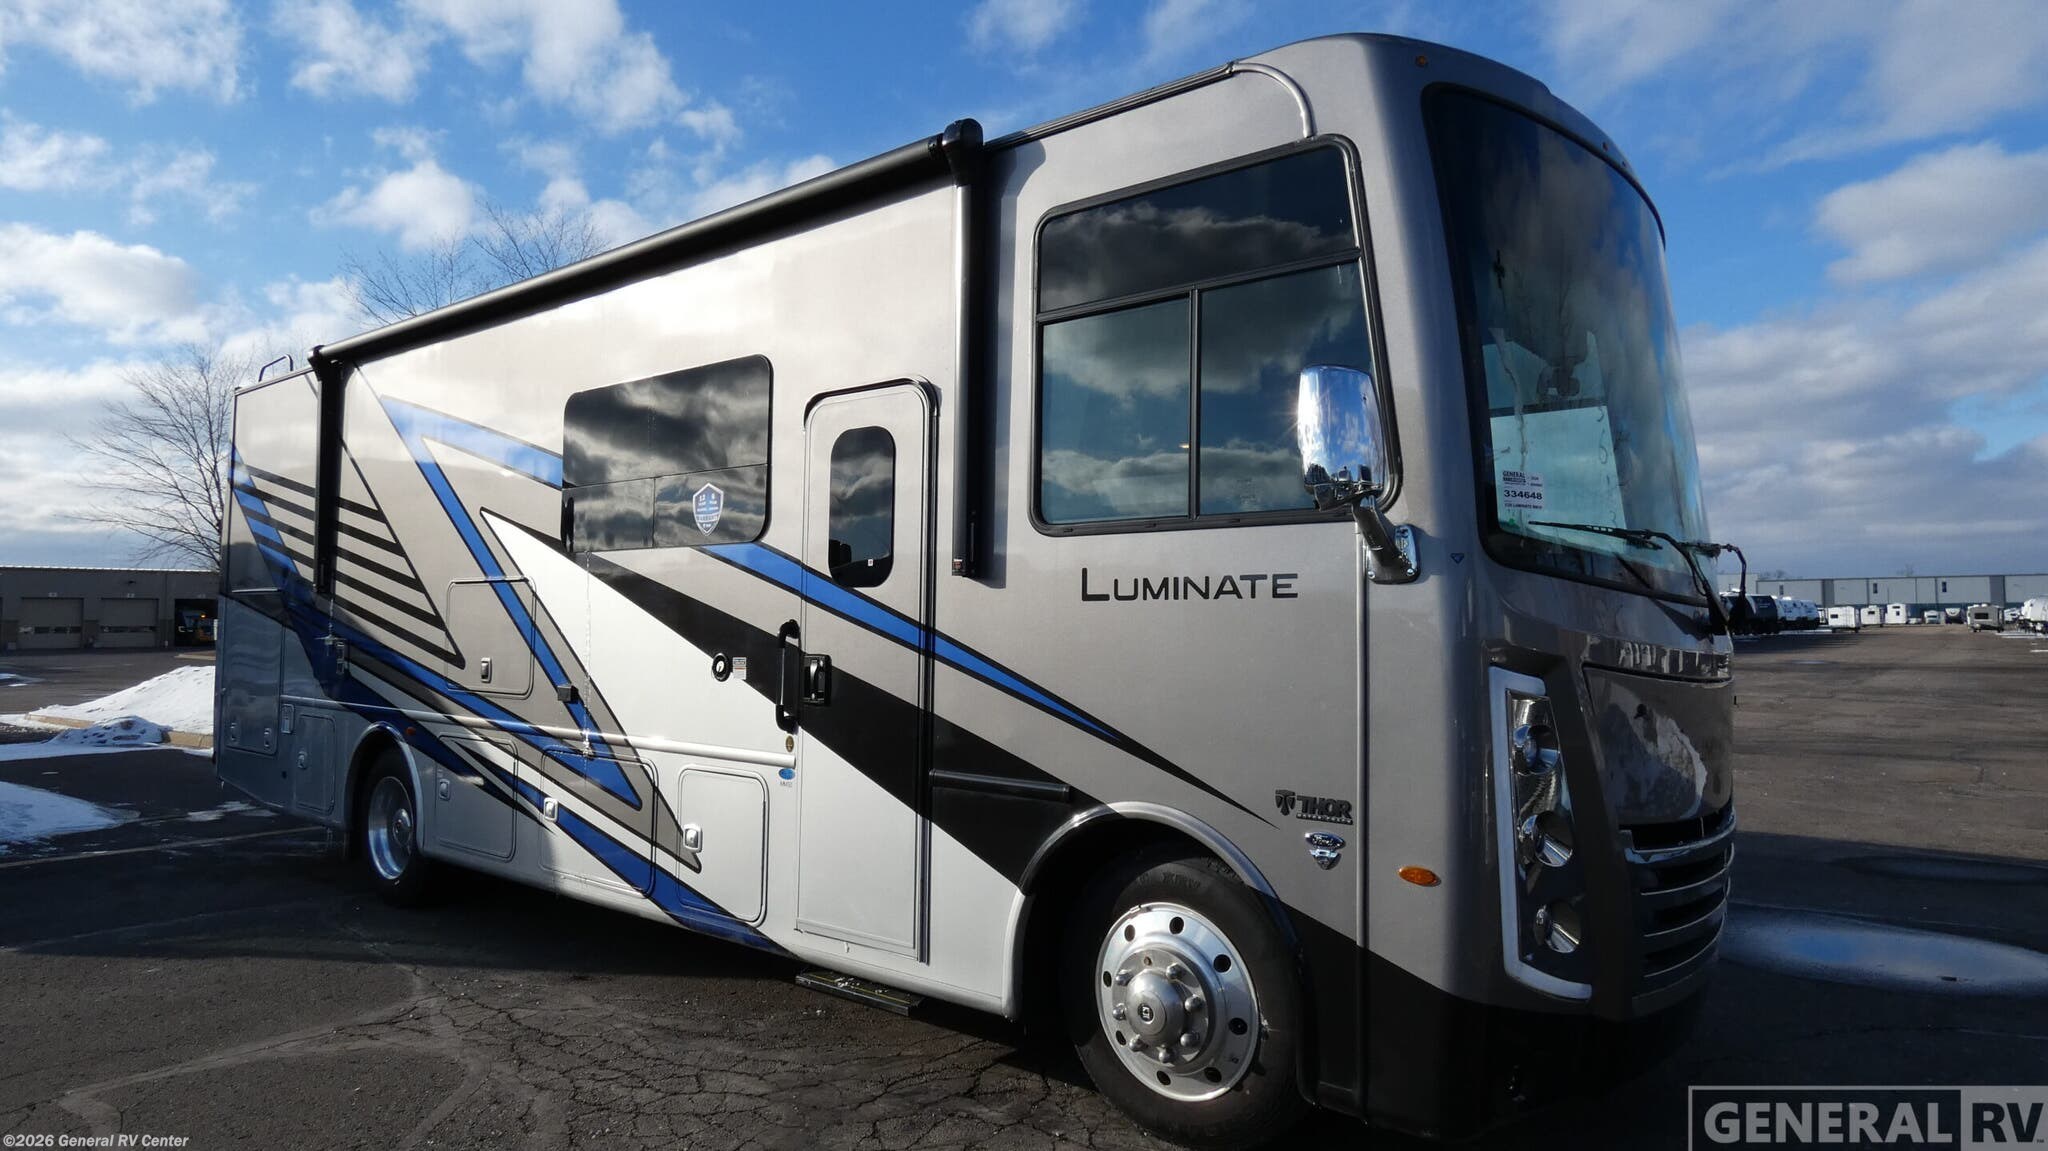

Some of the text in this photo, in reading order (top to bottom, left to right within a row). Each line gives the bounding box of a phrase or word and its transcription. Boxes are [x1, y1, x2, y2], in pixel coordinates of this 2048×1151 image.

[1504, 490, 1542, 500] 334648
[1081, 567, 1299, 602] LUMINATE
[1296, 795, 1353, 820] THOR
